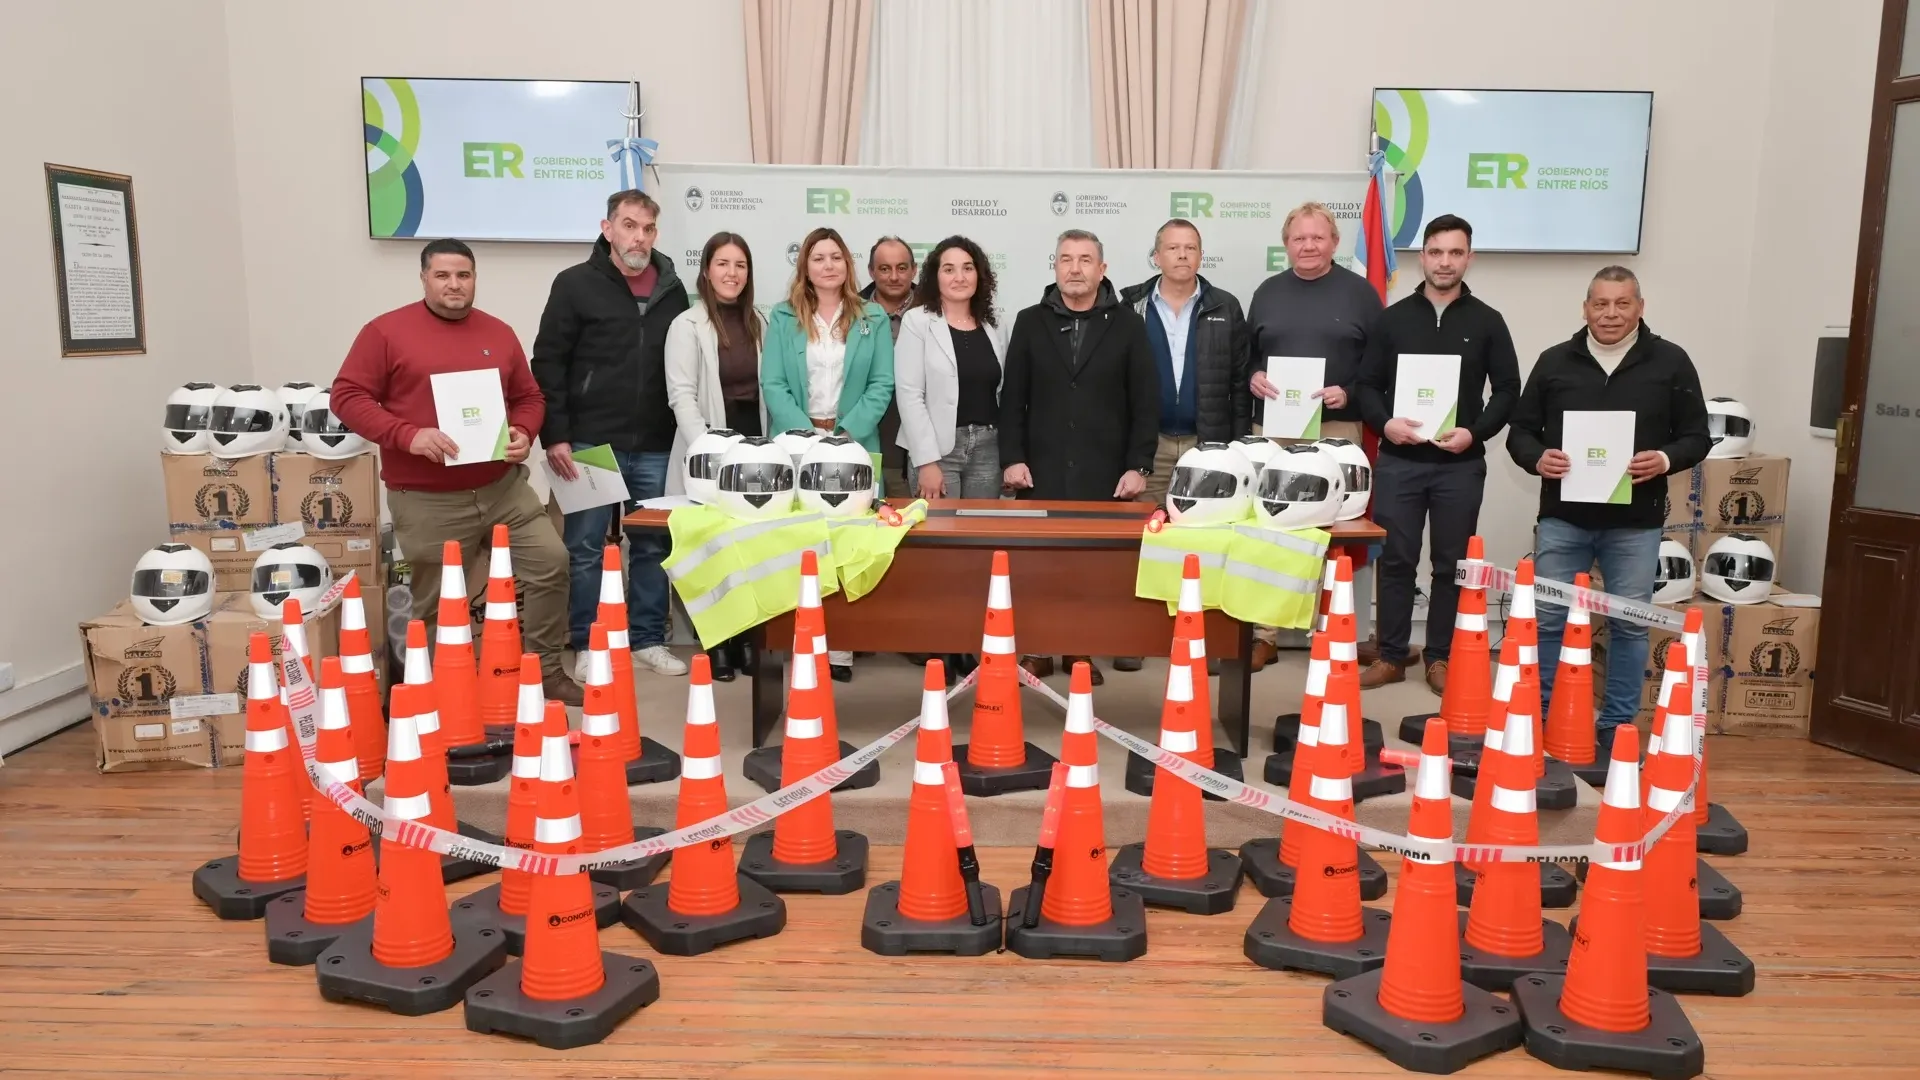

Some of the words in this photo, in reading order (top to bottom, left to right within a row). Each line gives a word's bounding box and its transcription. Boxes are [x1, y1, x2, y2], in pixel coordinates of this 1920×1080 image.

[463, 142, 525, 178] ER
[533, 156, 588, 166] GOBIERNO
[590, 157, 604, 166] DE
[533, 169, 573, 179] ENTRE
[576, 169, 605, 180] RÍOS
[1467, 153, 1530, 189] ER
[1537, 167, 1593, 176] GOBIERNO
[1595, 167, 1610, 176] DE
[1536, 179, 1577, 190] ENTRE
[1580, 179, 1609, 190] RÍOS
[743, 203, 756, 211] RÍOS
[806, 188, 850, 214] ER
[951, 199, 992, 207] ORGULLO
[993, 199, 999, 207] Y
[1170, 191, 1214, 218] ER
[1355, 202, 1362, 210] Y
[857, 207, 886, 215] ENTRE
[887, 206, 909, 215] RÍOS
[1220, 211, 1249, 219] ENTRE
[1250, 210, 1271, 219] RÍOS
[1285, 389, 1301, 399] ER
[1417, 388, 1435, 398] ER
[461, 407, 481, 419] ER
[1876, 403, 1910, 417] Sala
[1587, 447, 1607, 458] ER
[212, 490, 233, 516] 1
[318, 497, 337, 523] 1
[1733, 497, 1750, 524] 1
[1765, 648, 1784, 673] 1
[284, 658, 302, 685] PELIGRO
[135, 672, 158, 701] 1
[298, 713, 316, 739] PELIGRO
[352, 807, 384, 835] PELIGRO
